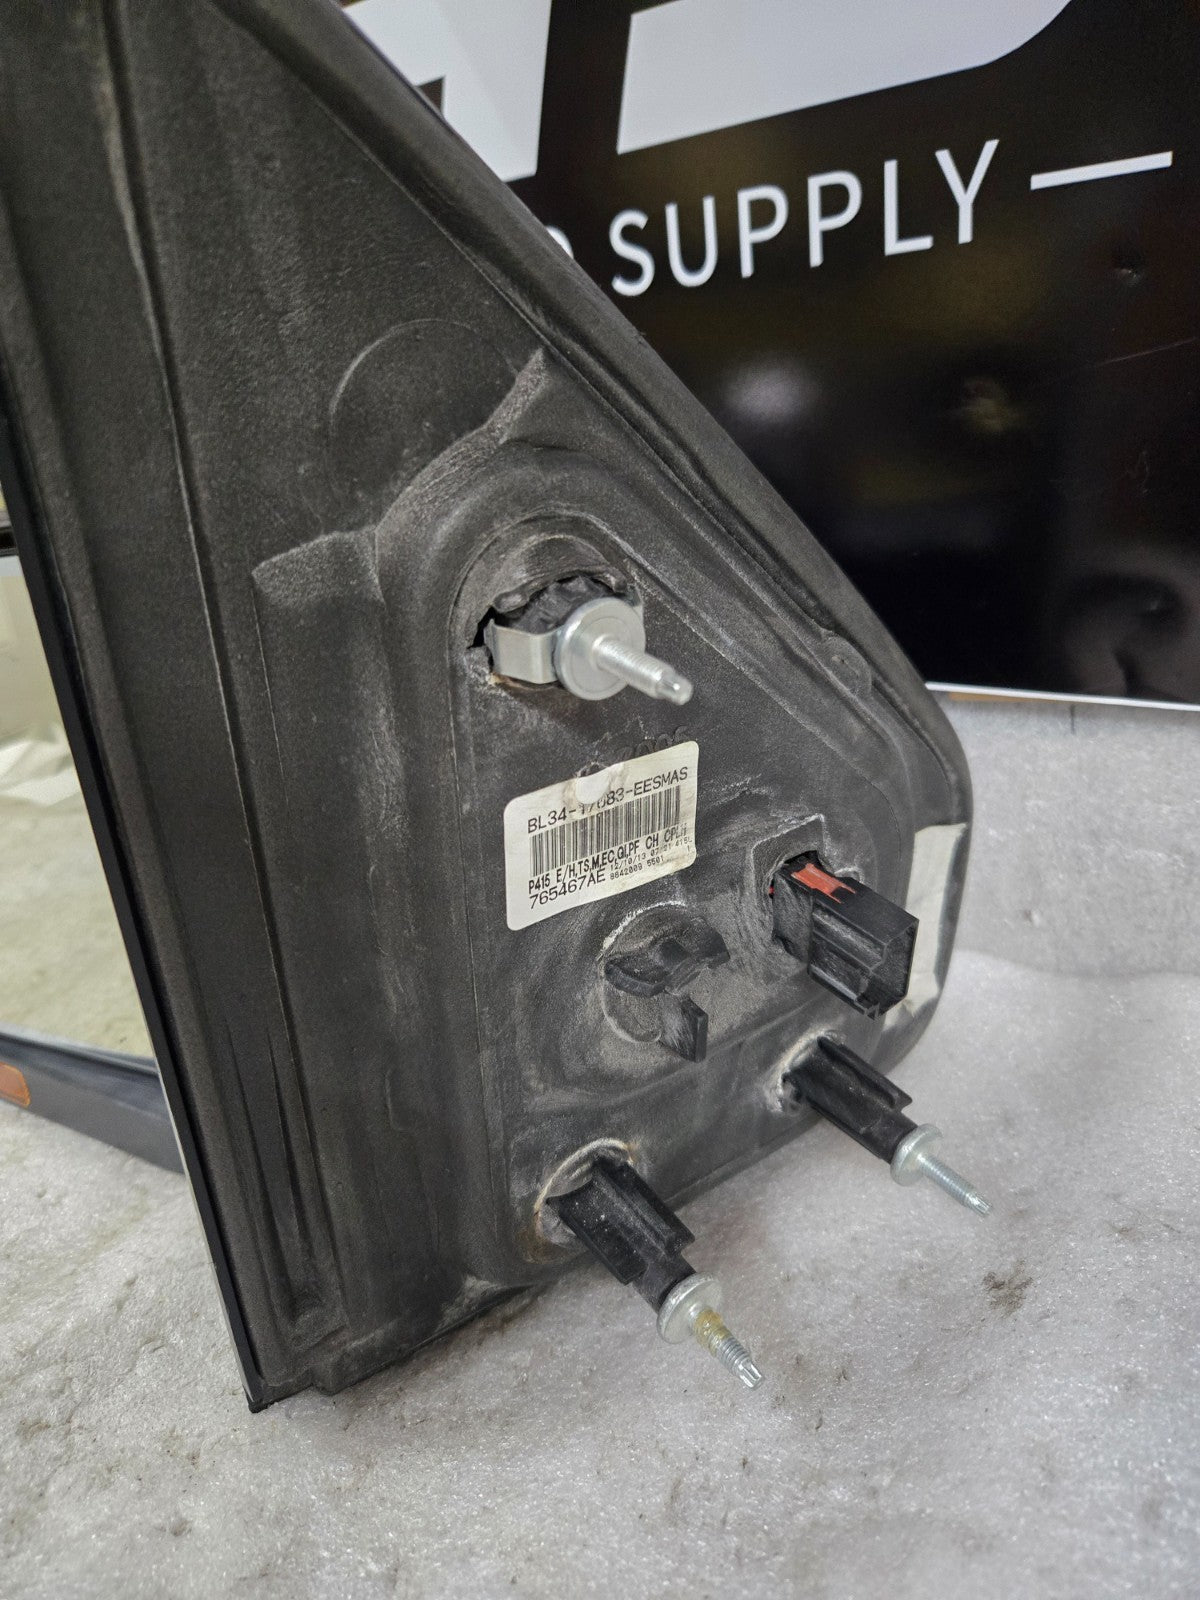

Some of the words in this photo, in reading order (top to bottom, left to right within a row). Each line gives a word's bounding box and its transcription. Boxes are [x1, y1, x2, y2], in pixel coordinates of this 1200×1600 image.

[611, 139, 1000, 297] SUPPLY
[528, 872, 551, 894] P415
[645, 832, 659, 849] CH
[529, 867, 606, 909] 765467AE
